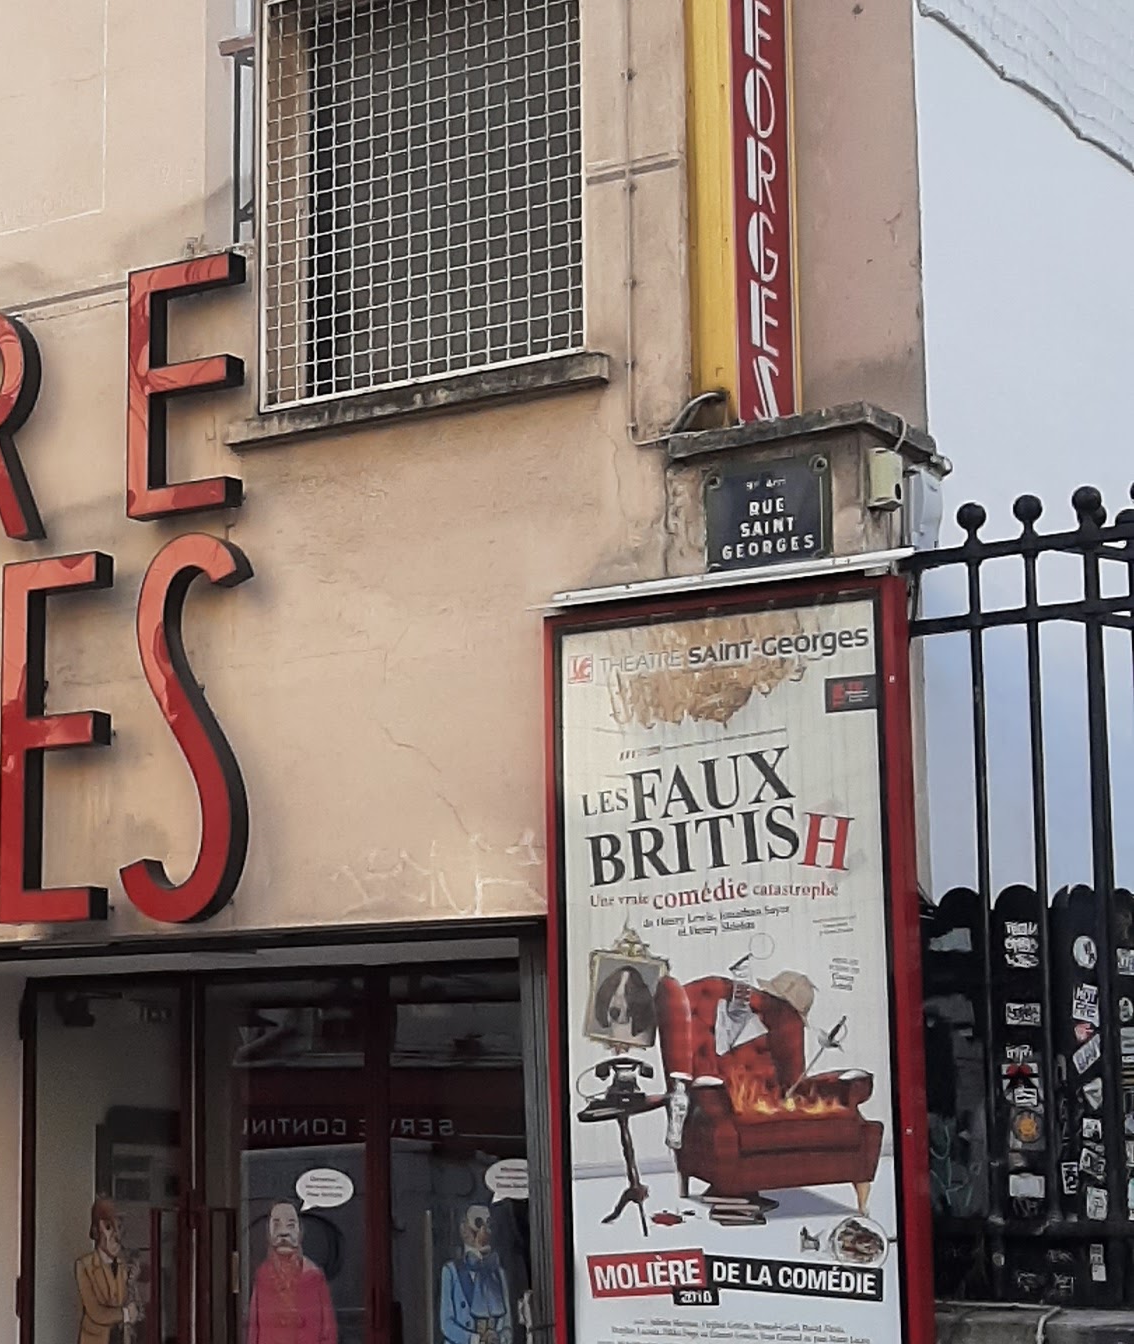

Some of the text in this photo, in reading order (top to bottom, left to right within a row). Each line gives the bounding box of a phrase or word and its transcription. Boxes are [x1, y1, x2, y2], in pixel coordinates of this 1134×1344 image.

[749, 497, 784, 517] RUE
[740, 516, 794, 538] SAINT
[722, 534, 815, 560] GEORGES
[581, 788, 628, 817] LES
[626, 745, 797, 824] FAUX
[585, 804, 855, 888] BRITISH
[653, 878, 748, 910] comédie
[753, 881, 839, 901] catastrophe
[593, 1254, 878, 1295] MOLIÈRE DE LA COMÉDIE
